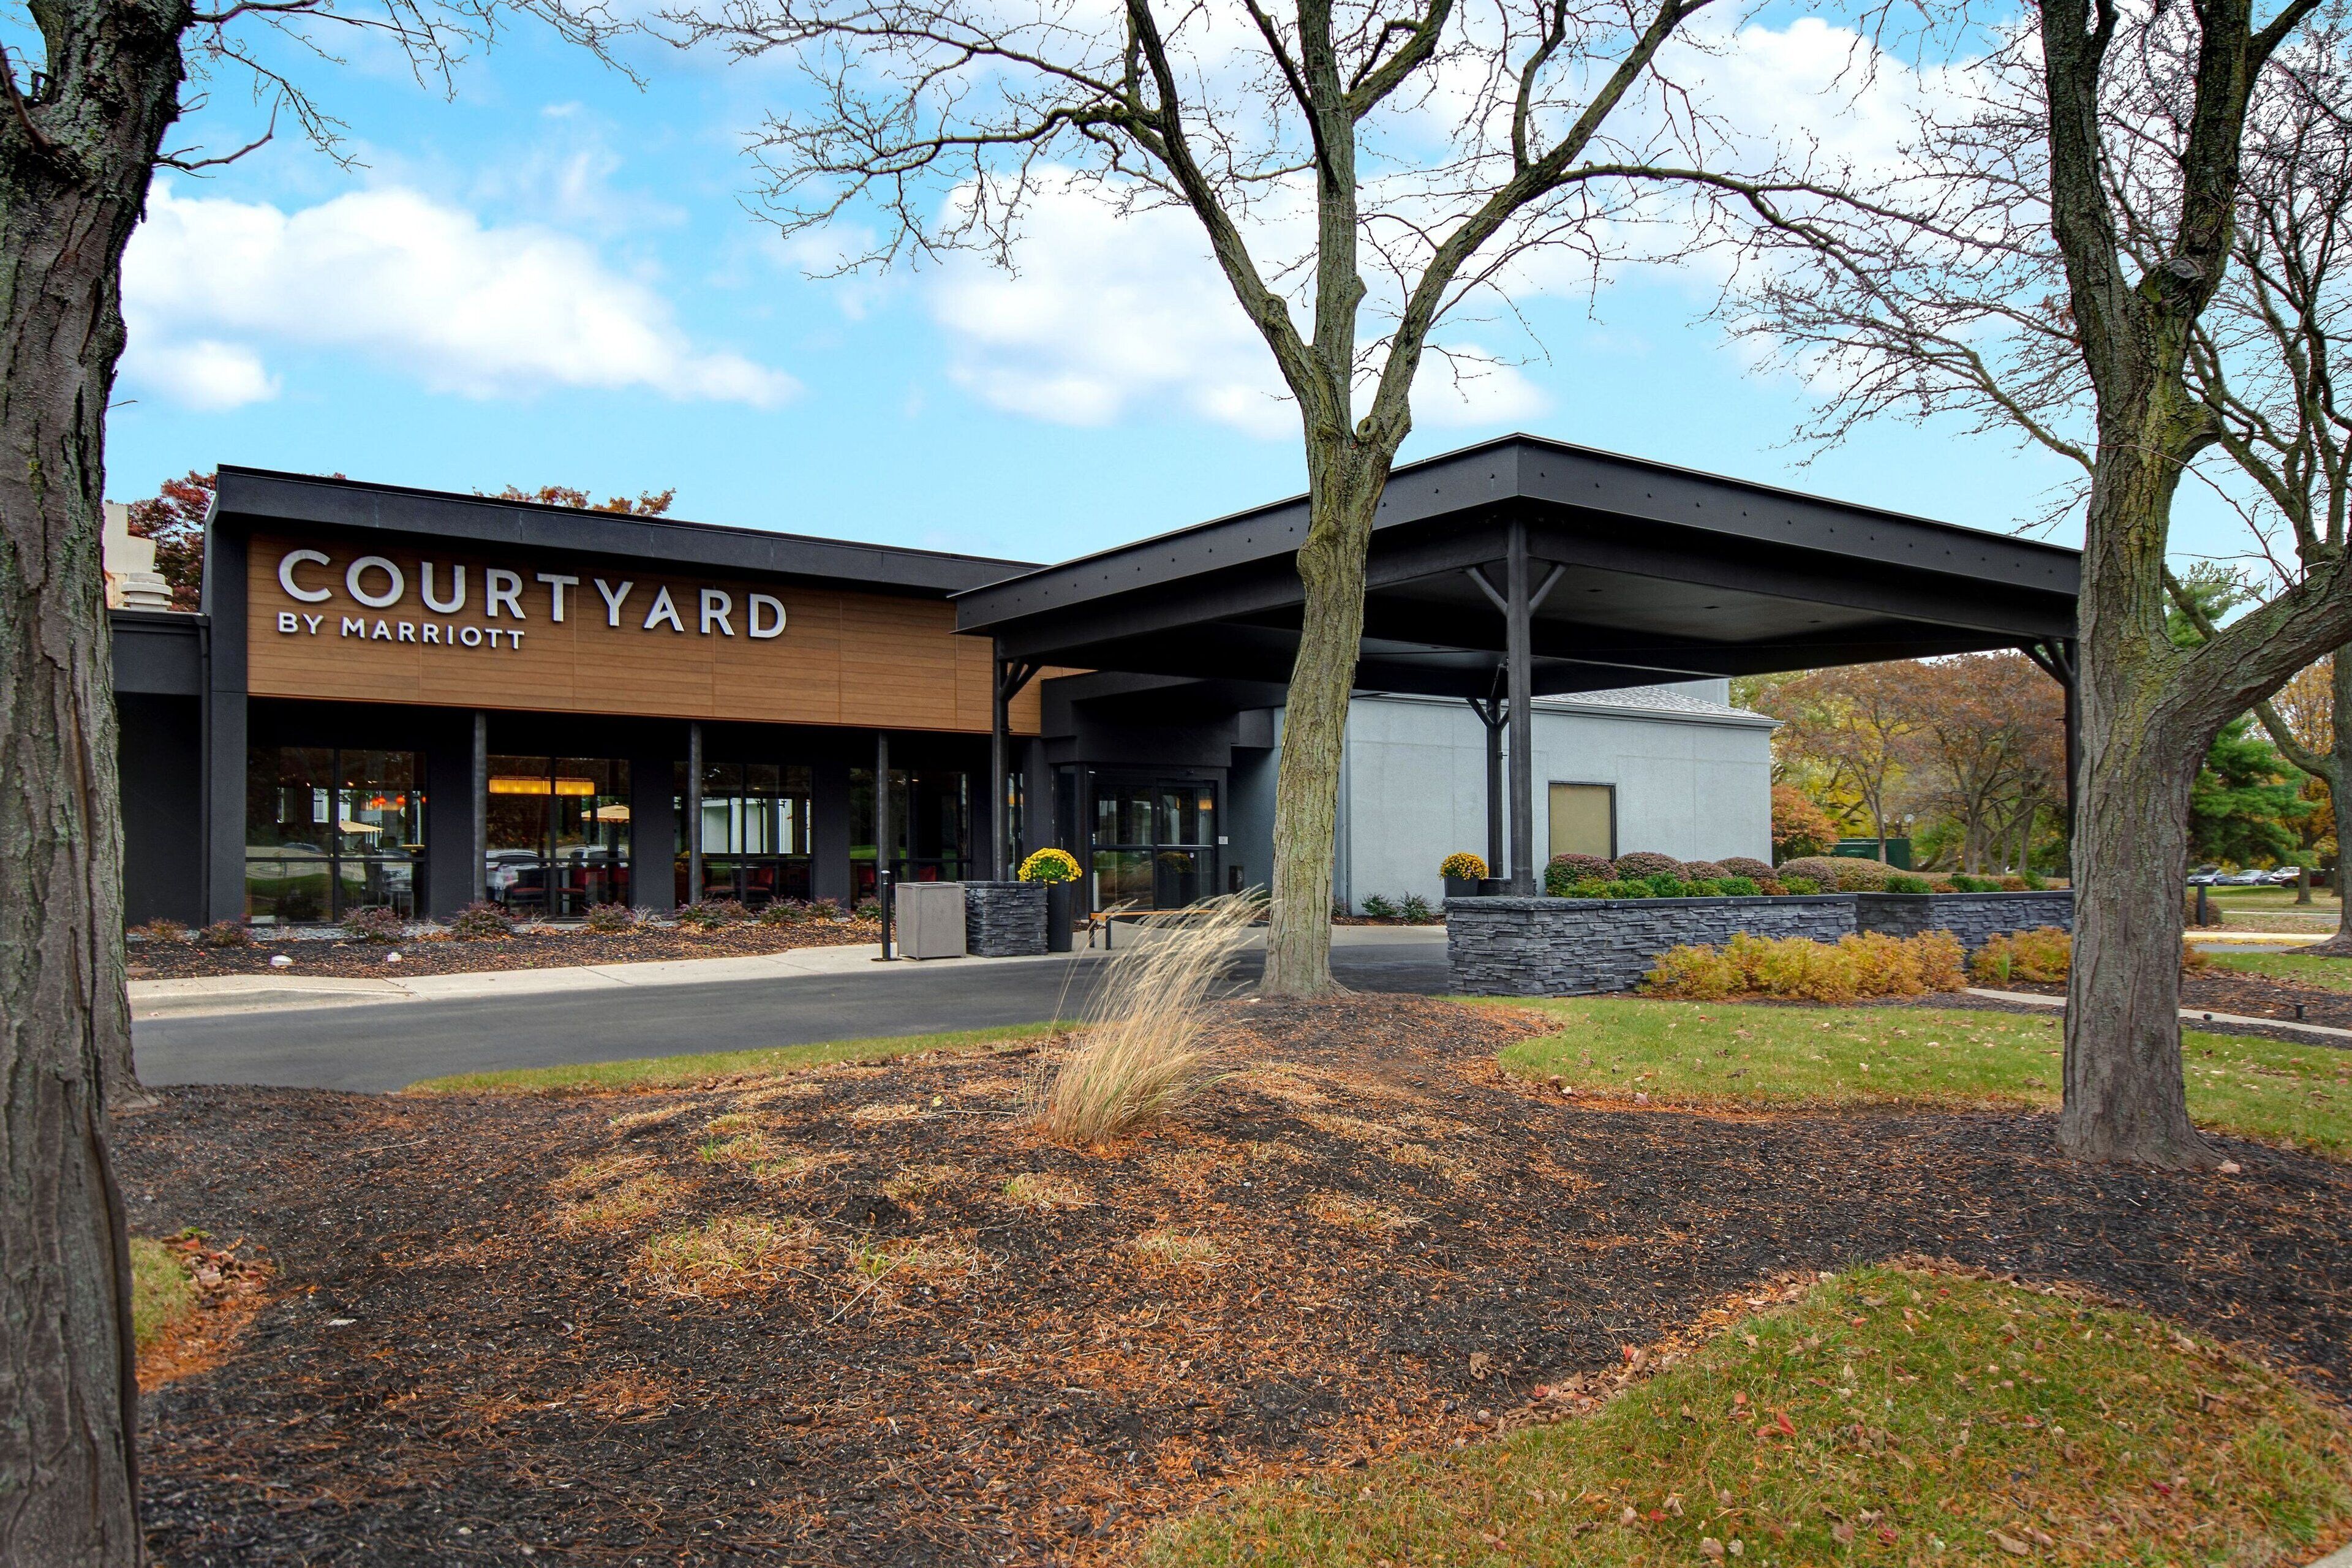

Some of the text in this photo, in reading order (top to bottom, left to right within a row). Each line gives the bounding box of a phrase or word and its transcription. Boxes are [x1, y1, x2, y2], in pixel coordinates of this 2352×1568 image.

[278, 549, 787, 638] COURTYARD
[278, 612, 526, 650] BY MARRIOTT
